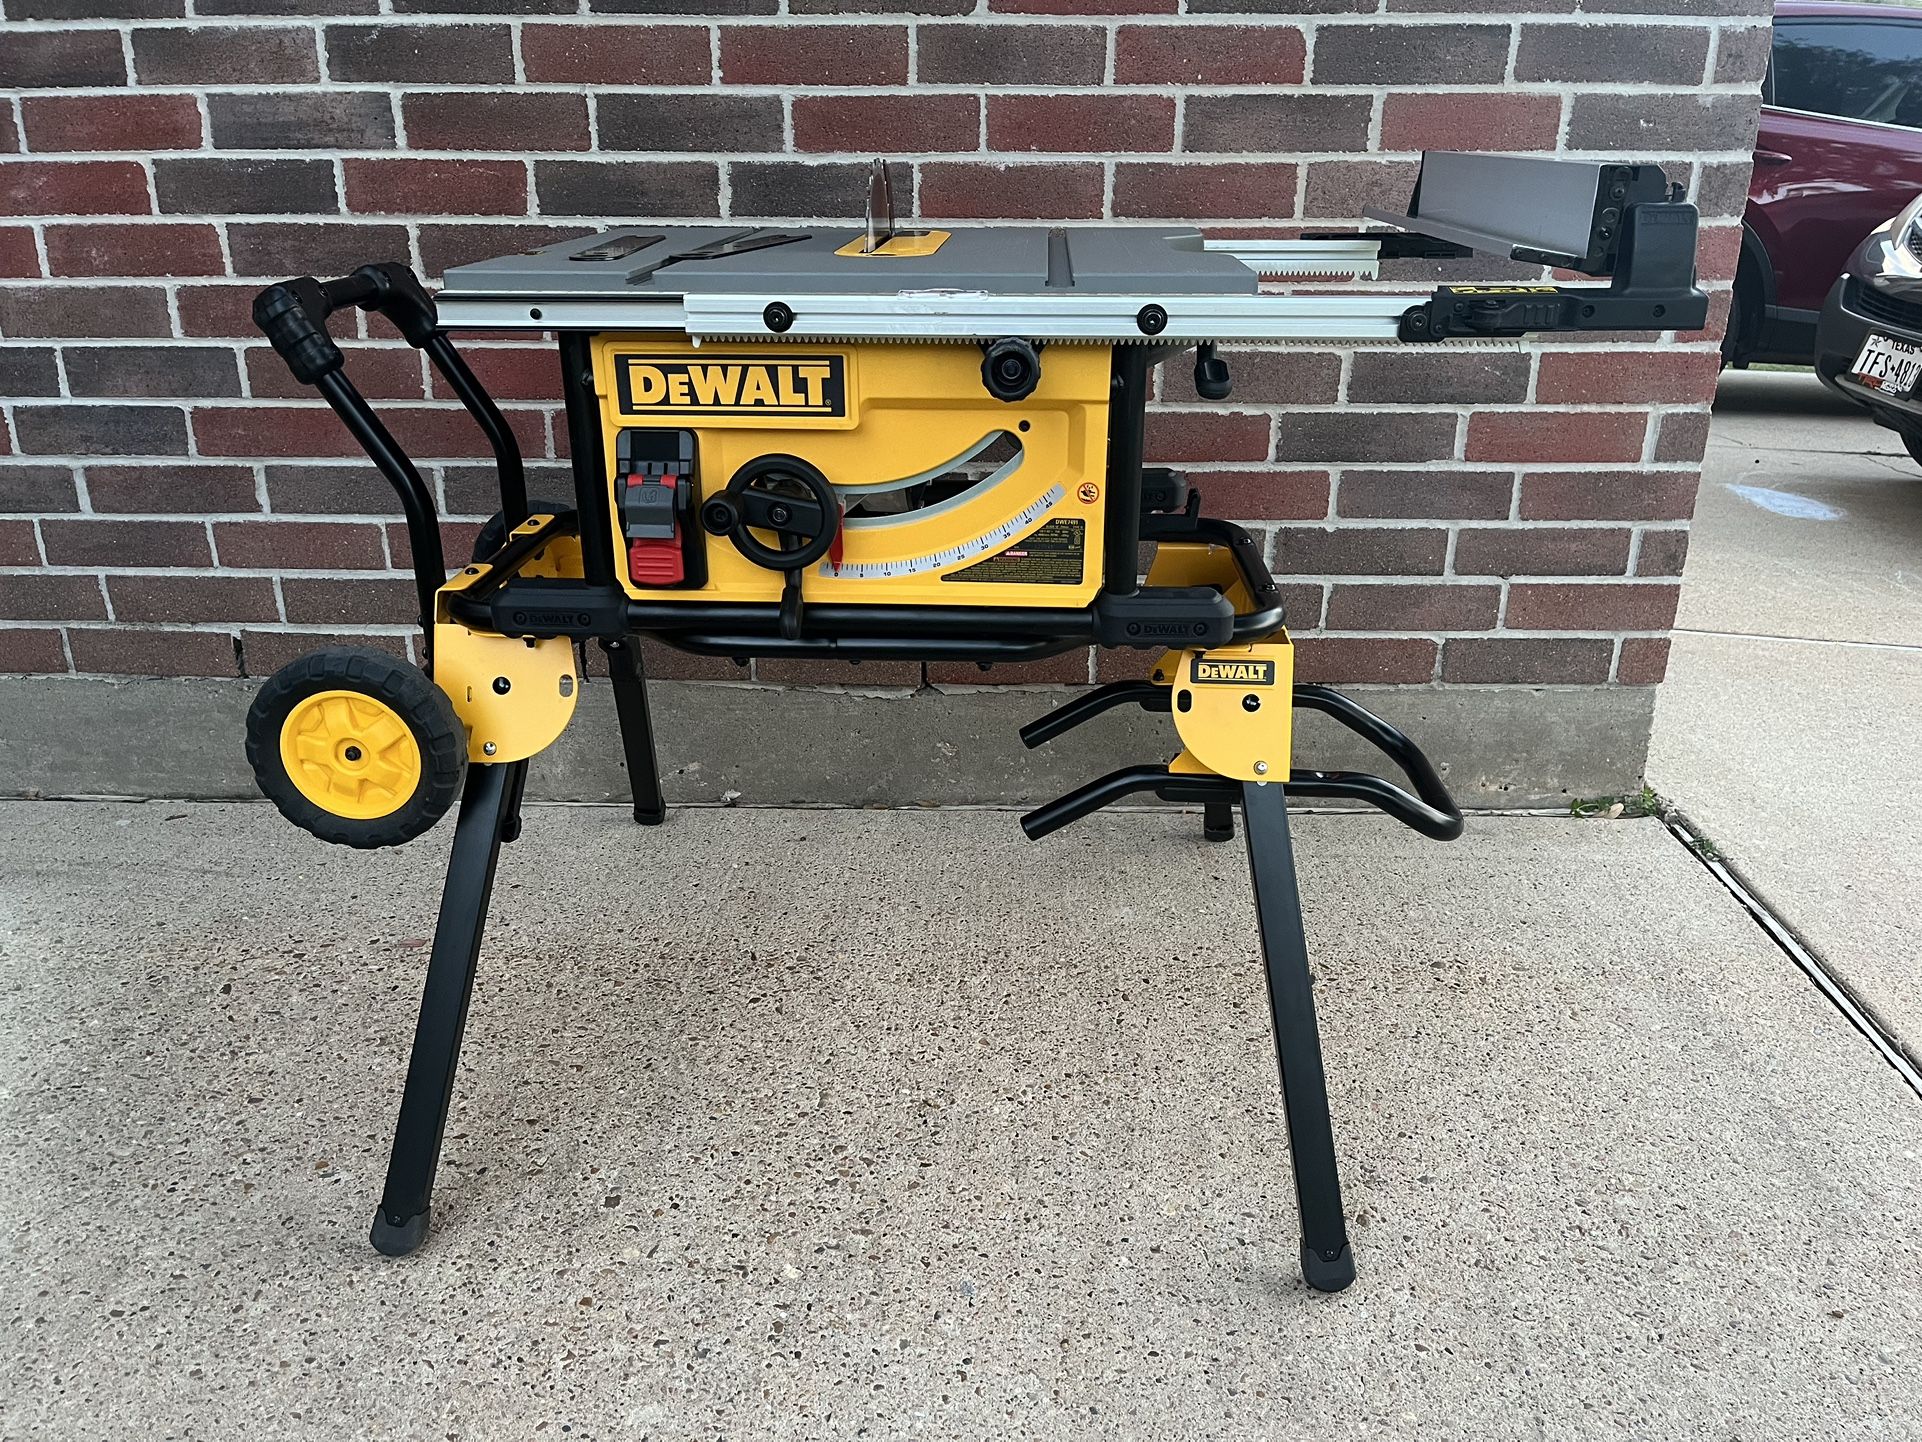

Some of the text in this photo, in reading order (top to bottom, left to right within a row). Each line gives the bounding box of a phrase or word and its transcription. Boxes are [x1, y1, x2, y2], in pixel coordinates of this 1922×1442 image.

[1891, 340, 1915, 355] TEXAS
[1025, 517, 1033, 525] 40
[1045, 501, 1053, 509] 45
